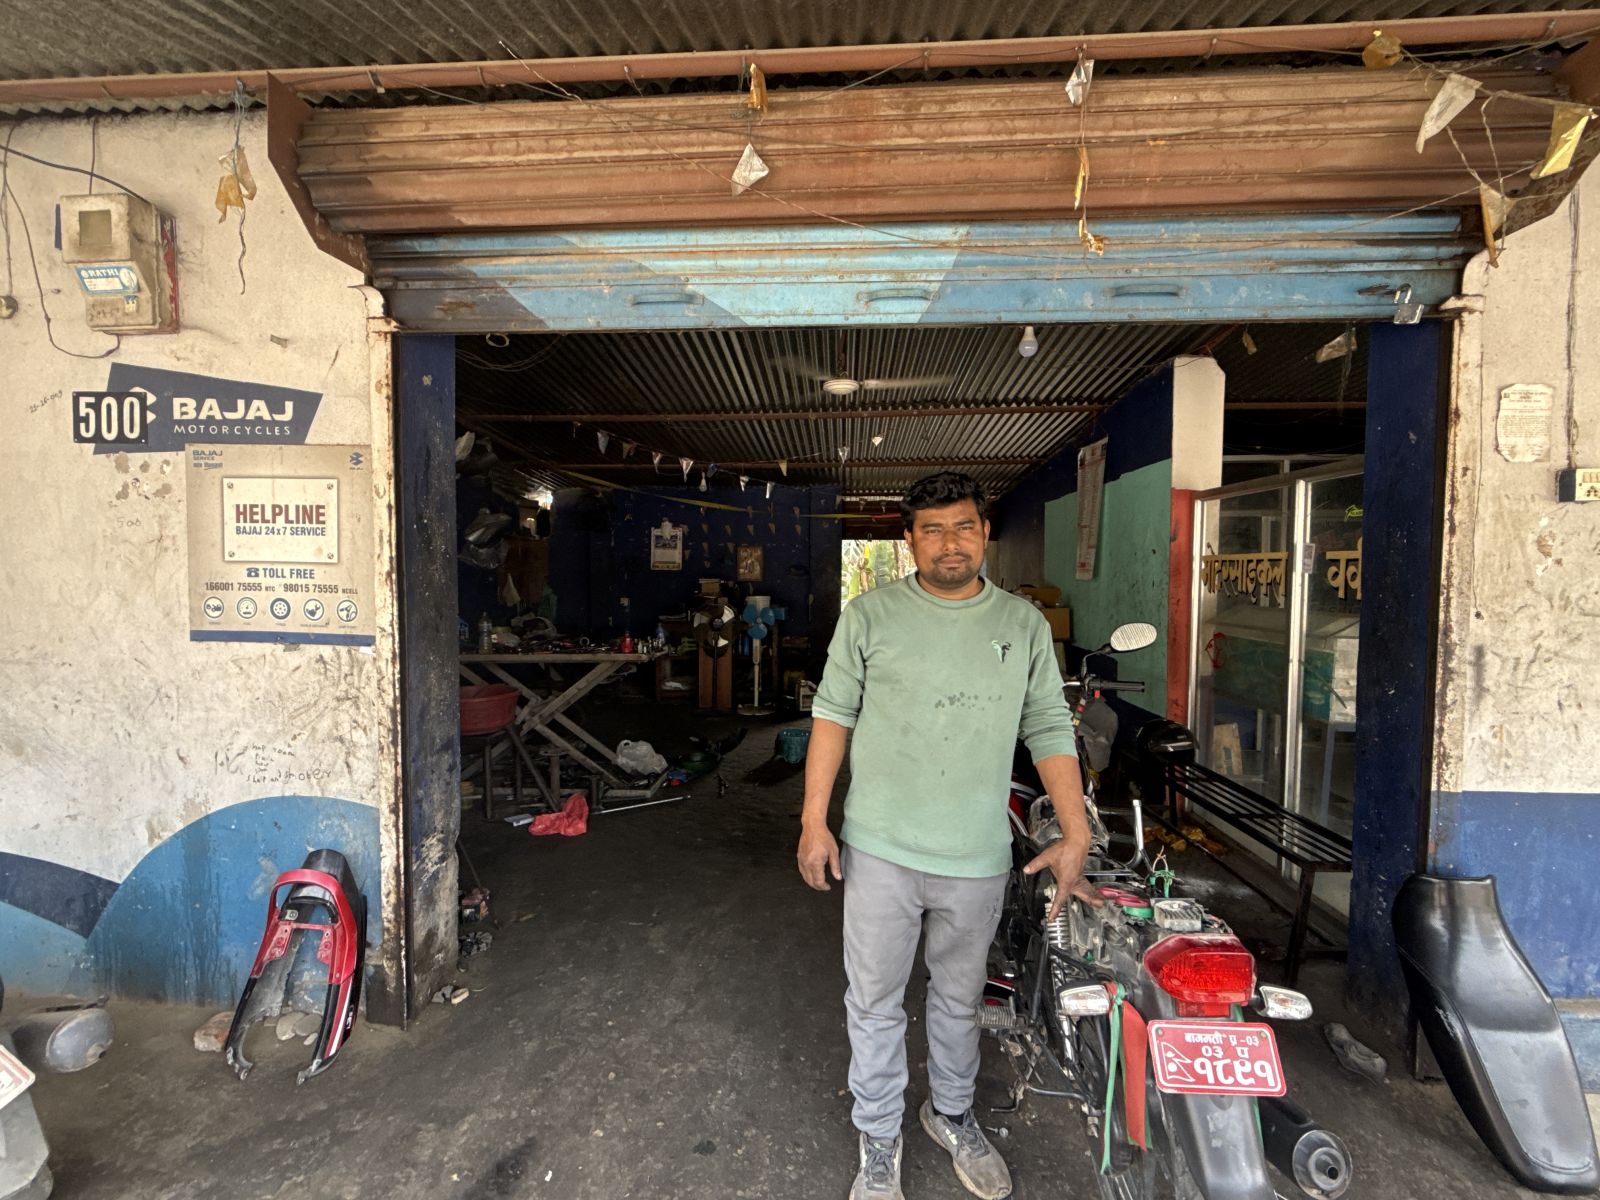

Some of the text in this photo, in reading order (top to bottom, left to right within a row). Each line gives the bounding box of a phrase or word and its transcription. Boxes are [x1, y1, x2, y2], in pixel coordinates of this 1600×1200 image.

[172, 397, 294, 422] BAJAJ
[79, 396, 140, 441] 500
[173, 424, 291, 436] MOTORCYCLES
[235, 503, 326, 525] HELPLINE
[236, 526, 262, 535] BAJAJ
[290, 526, 326, 536] SERVICE
[262, 567, 315, 580] TOLL FREE
[237, 582, 262, 592] 75555
[283, 583, 310, 593] 98015
[312, 584, 339, 594] 75555
